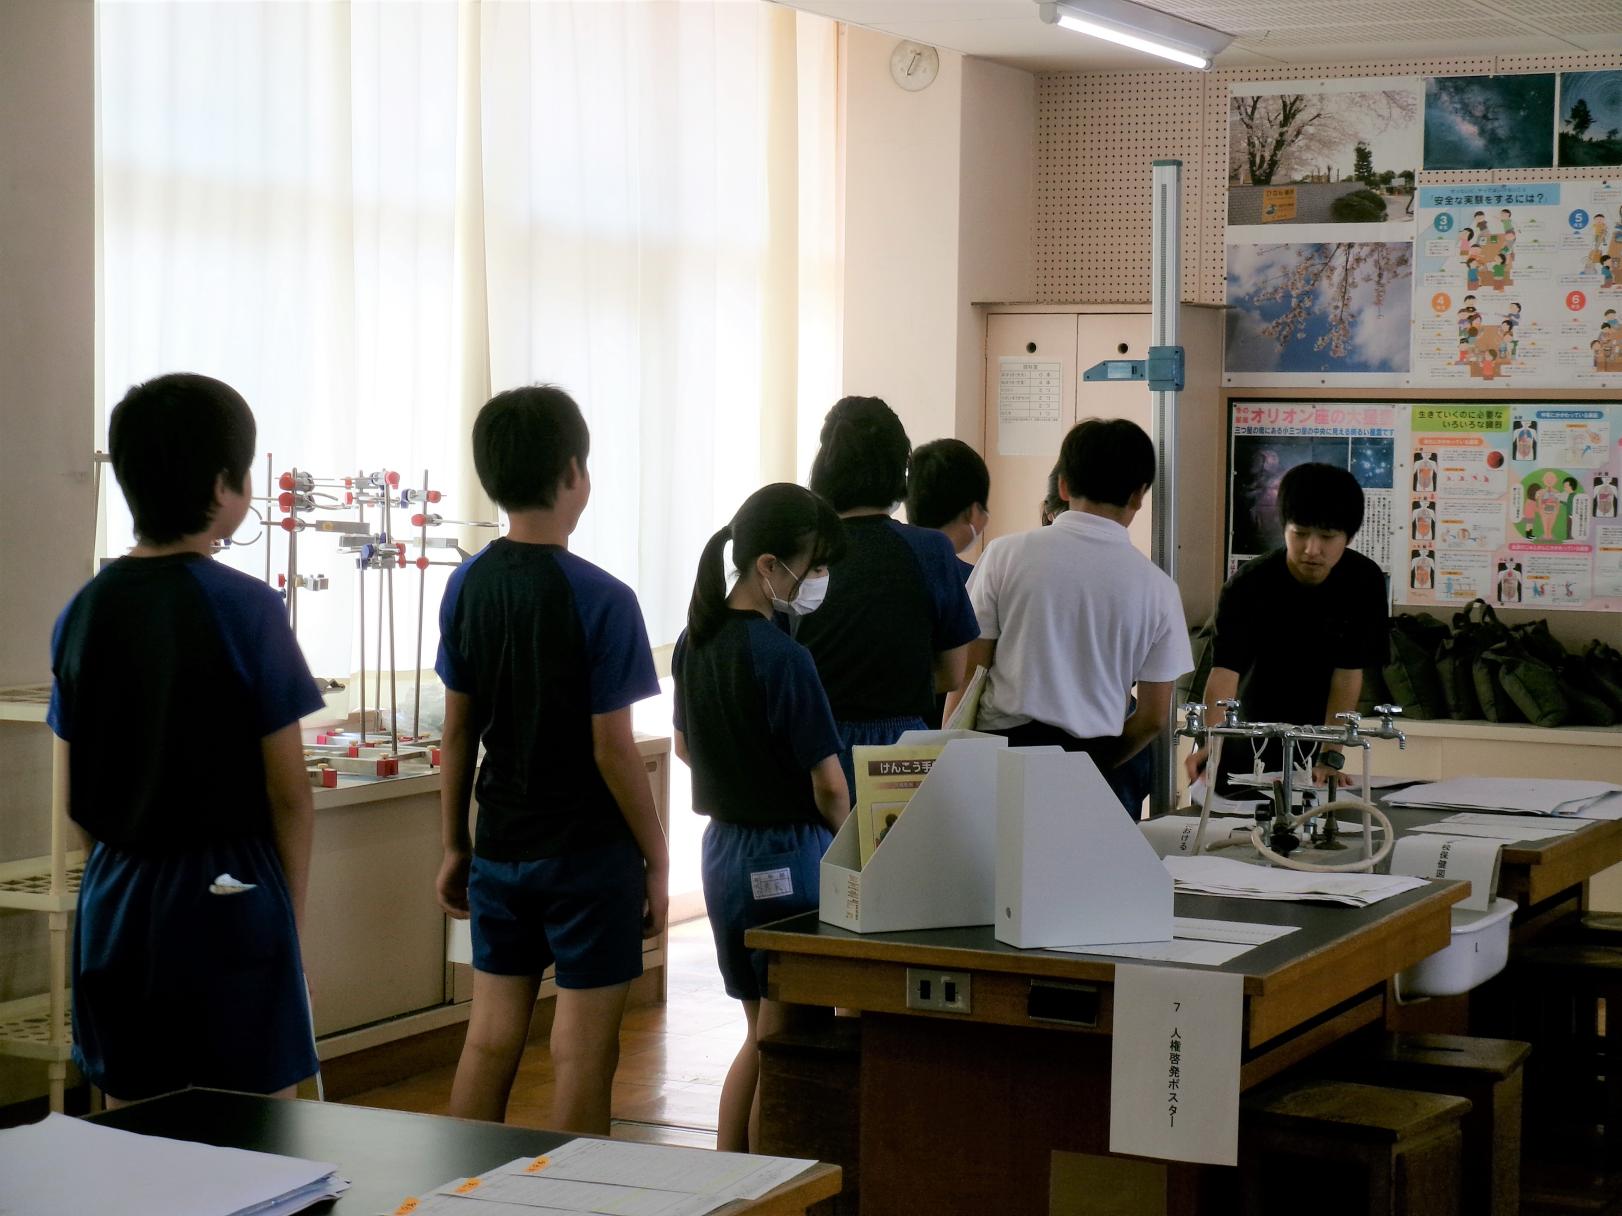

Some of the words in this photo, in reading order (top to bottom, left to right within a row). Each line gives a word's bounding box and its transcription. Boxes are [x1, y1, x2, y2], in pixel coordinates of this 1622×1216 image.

[1439, 215, 1448, 225] 3
[1574, 212, 1583, 222] 5
[1437, 295, 1446, 305] 4
[1571, 294, 1580, 304] 6
[880, 760, 935, 774] けんこう手
[1172, 1002, 1181, 1012] 7
[1168, 1026, 1182, 1128] 人権啓発ポスター
